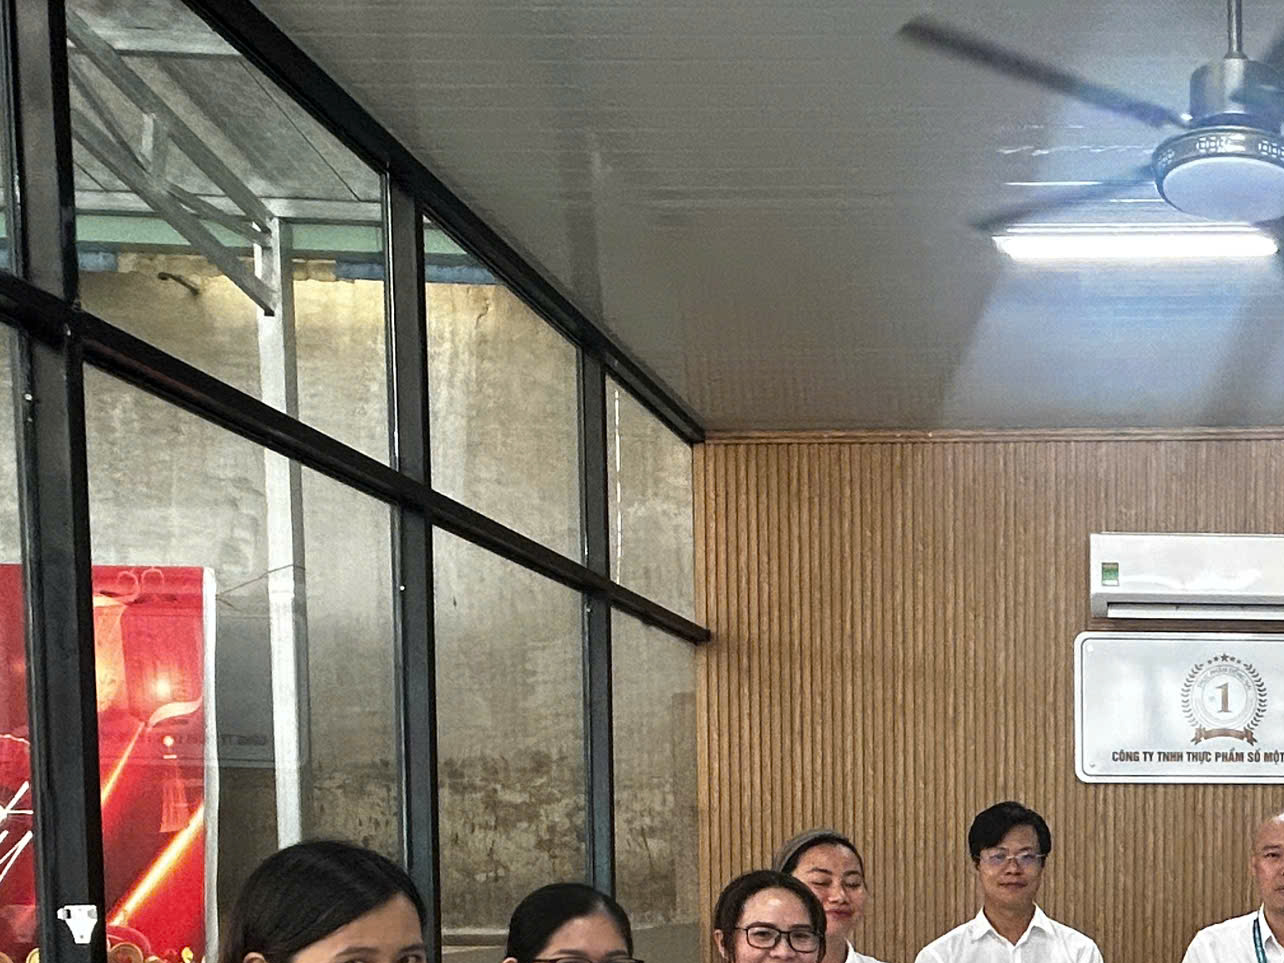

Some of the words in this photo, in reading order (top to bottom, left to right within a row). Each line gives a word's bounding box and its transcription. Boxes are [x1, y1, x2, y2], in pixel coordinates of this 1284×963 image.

[1215, 682, 1233, 713] 1
[1111, 749, 1140, 762] CÔNG
[1142, 751, 1155, 762] TY
[1157, 751, 1183, 762] TNHH
[1186, 750, 1212, 763] THỰC
[1214, 747, 1244, 763] PHẨM
[1247, 748, 1262, 762] SỐ
[1264, 750, 1284, 765] MỘT
